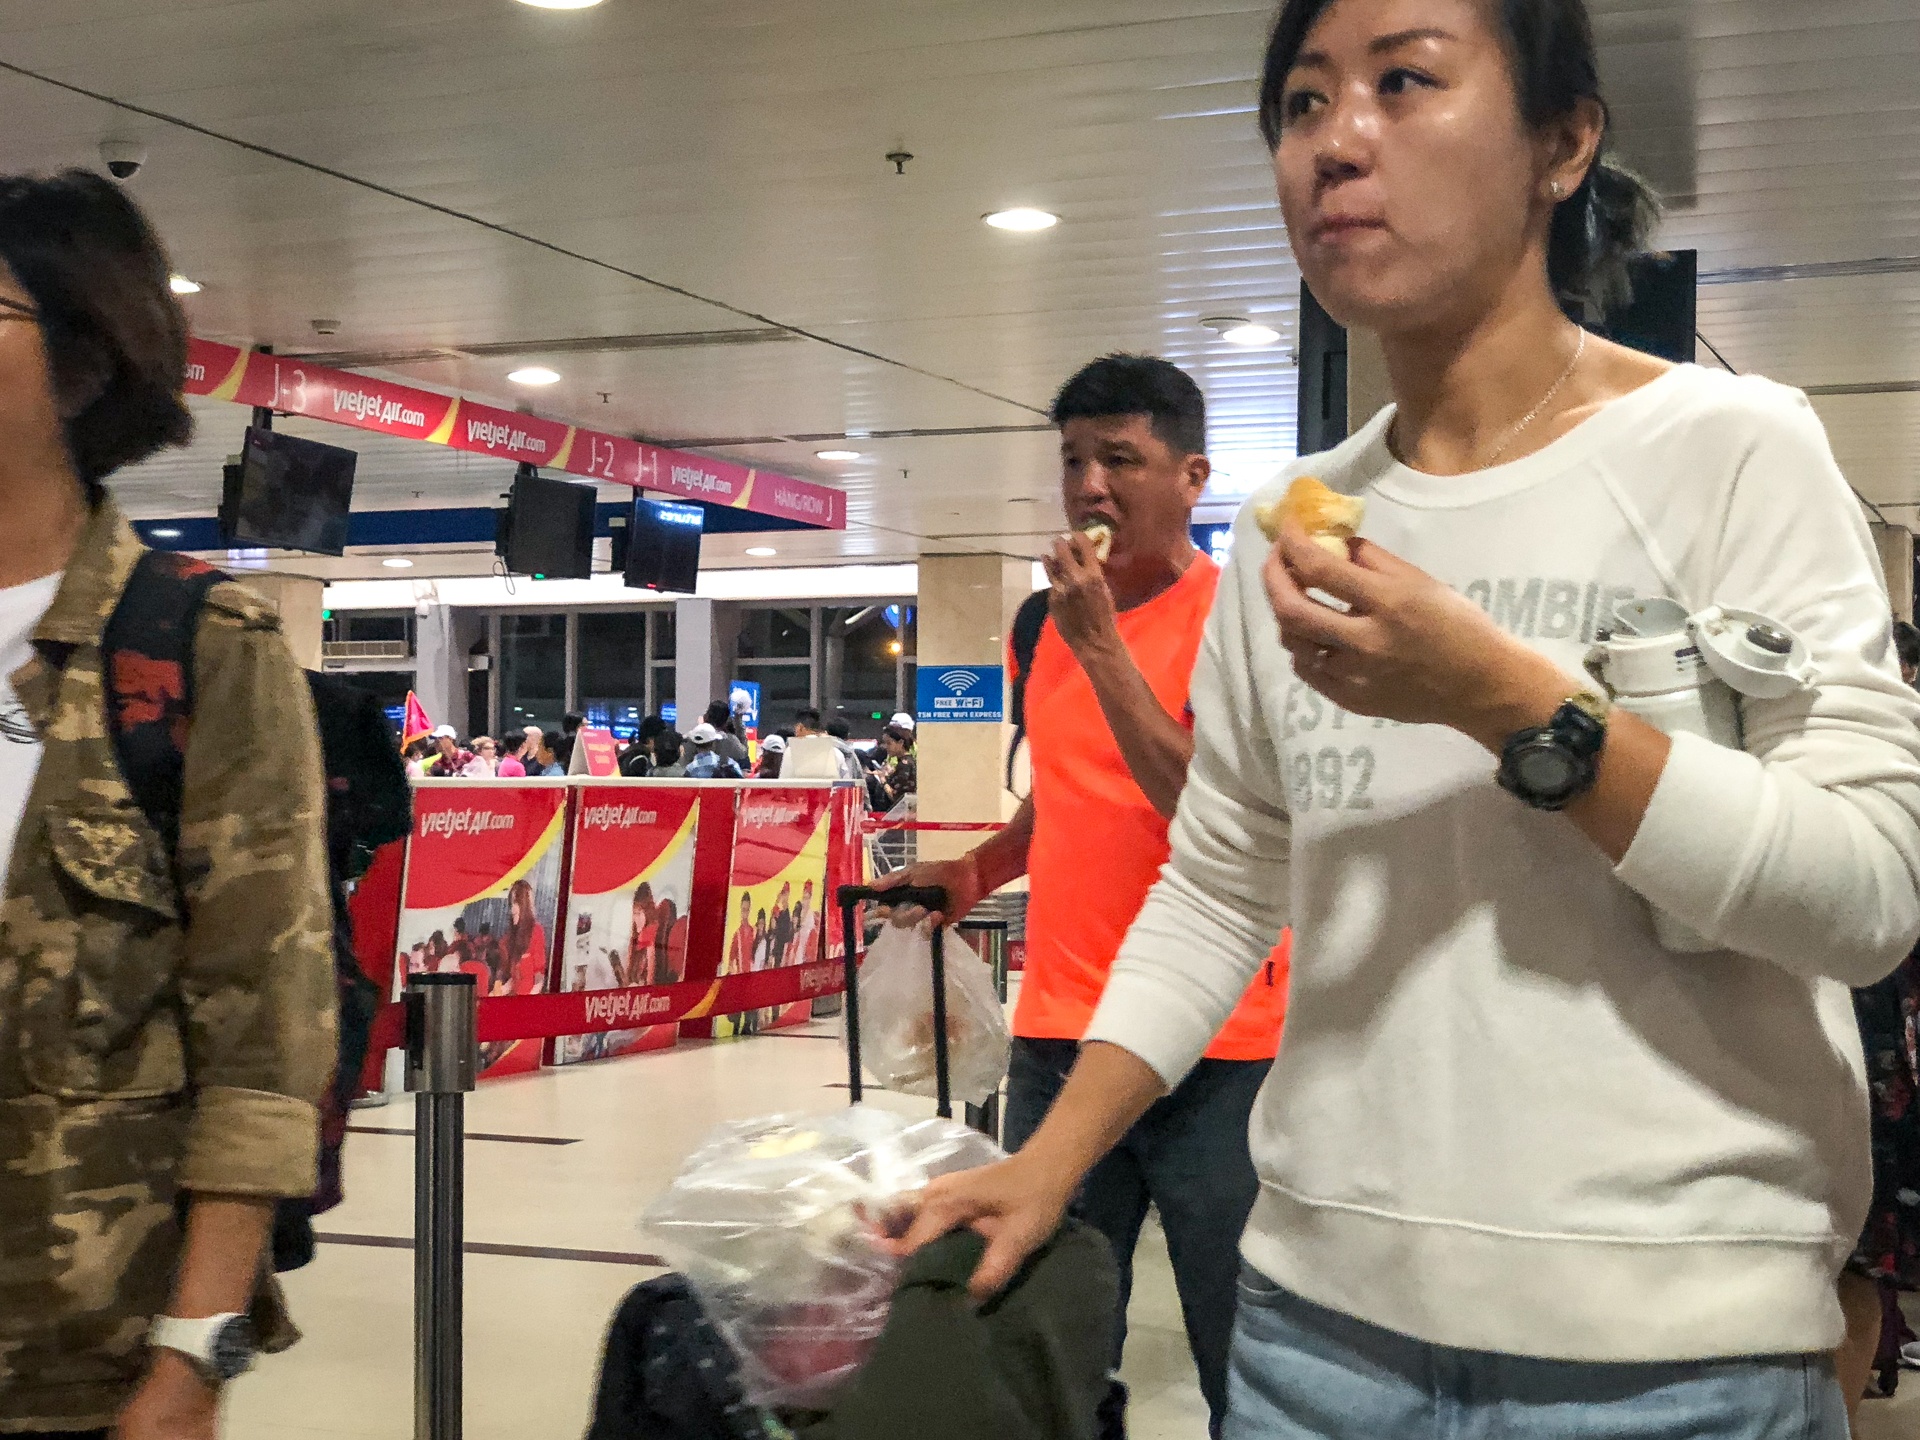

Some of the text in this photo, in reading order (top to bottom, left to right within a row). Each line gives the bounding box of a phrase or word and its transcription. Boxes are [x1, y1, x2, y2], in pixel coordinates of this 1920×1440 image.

[267, 363, 307, 413] J-3
[588, 436, 614, 478] J-2
[634, 446, 657, 485] J-1
